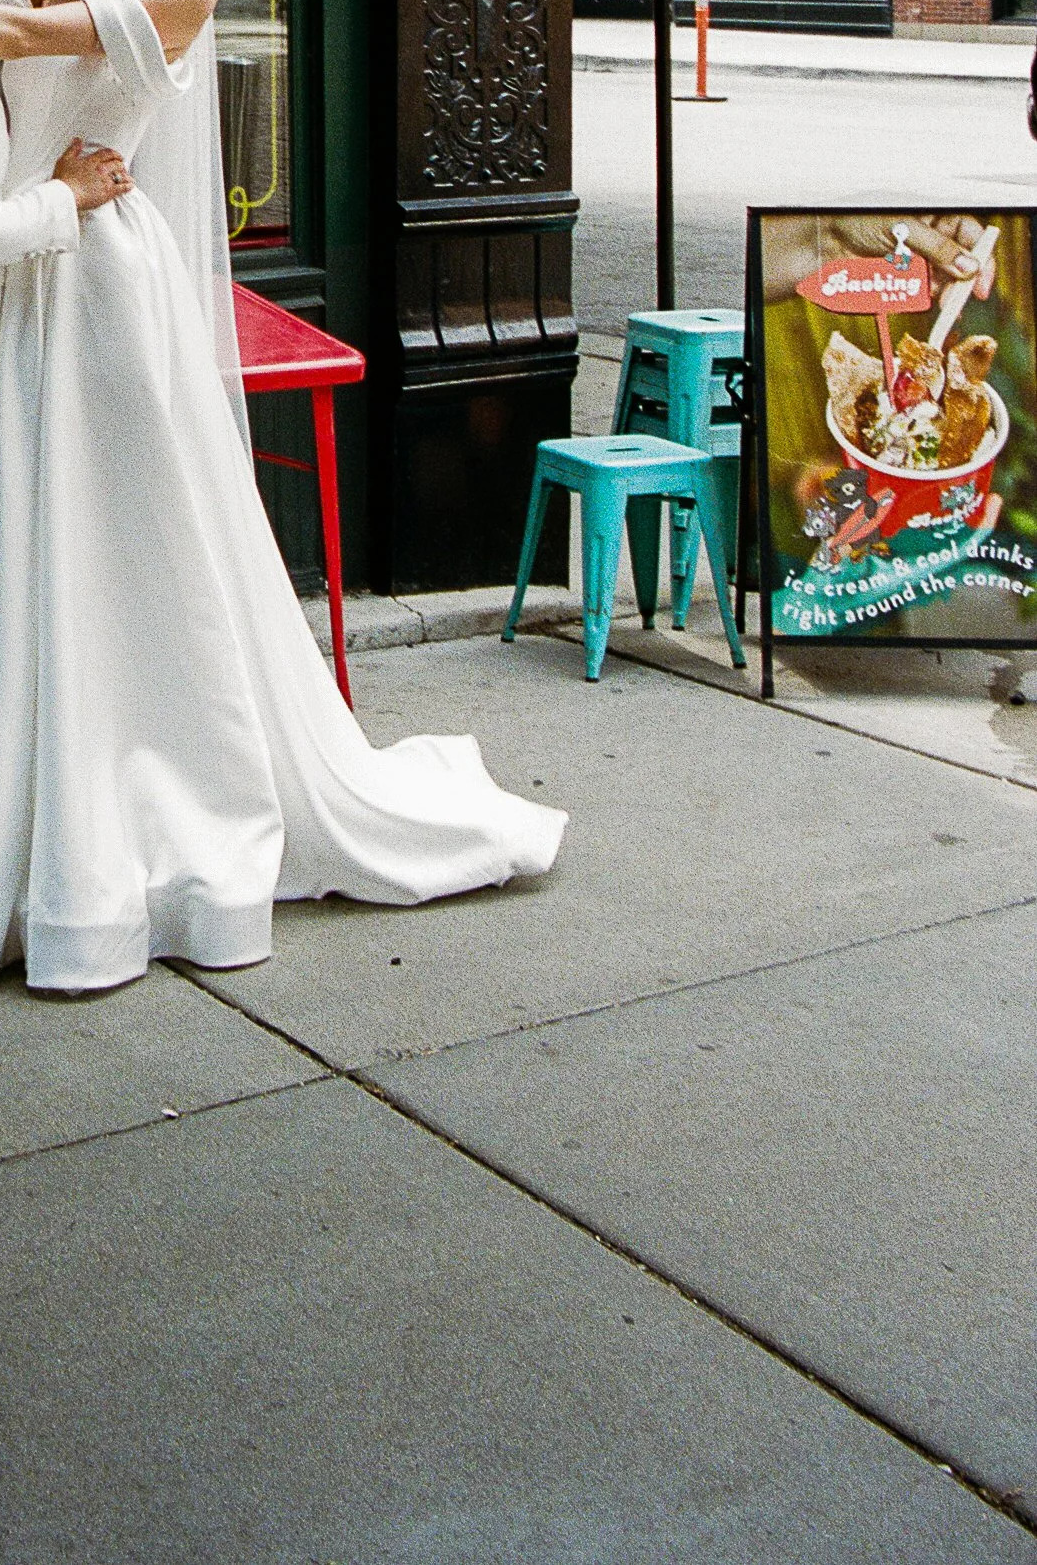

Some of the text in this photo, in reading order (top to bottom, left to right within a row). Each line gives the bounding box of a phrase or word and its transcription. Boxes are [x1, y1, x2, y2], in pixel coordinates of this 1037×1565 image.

[881, 291, 907, 303] BAR
[784, 538, 1035, 598] ice cream & cool drinks
[782, 572, 1036, 632] right around the corner
